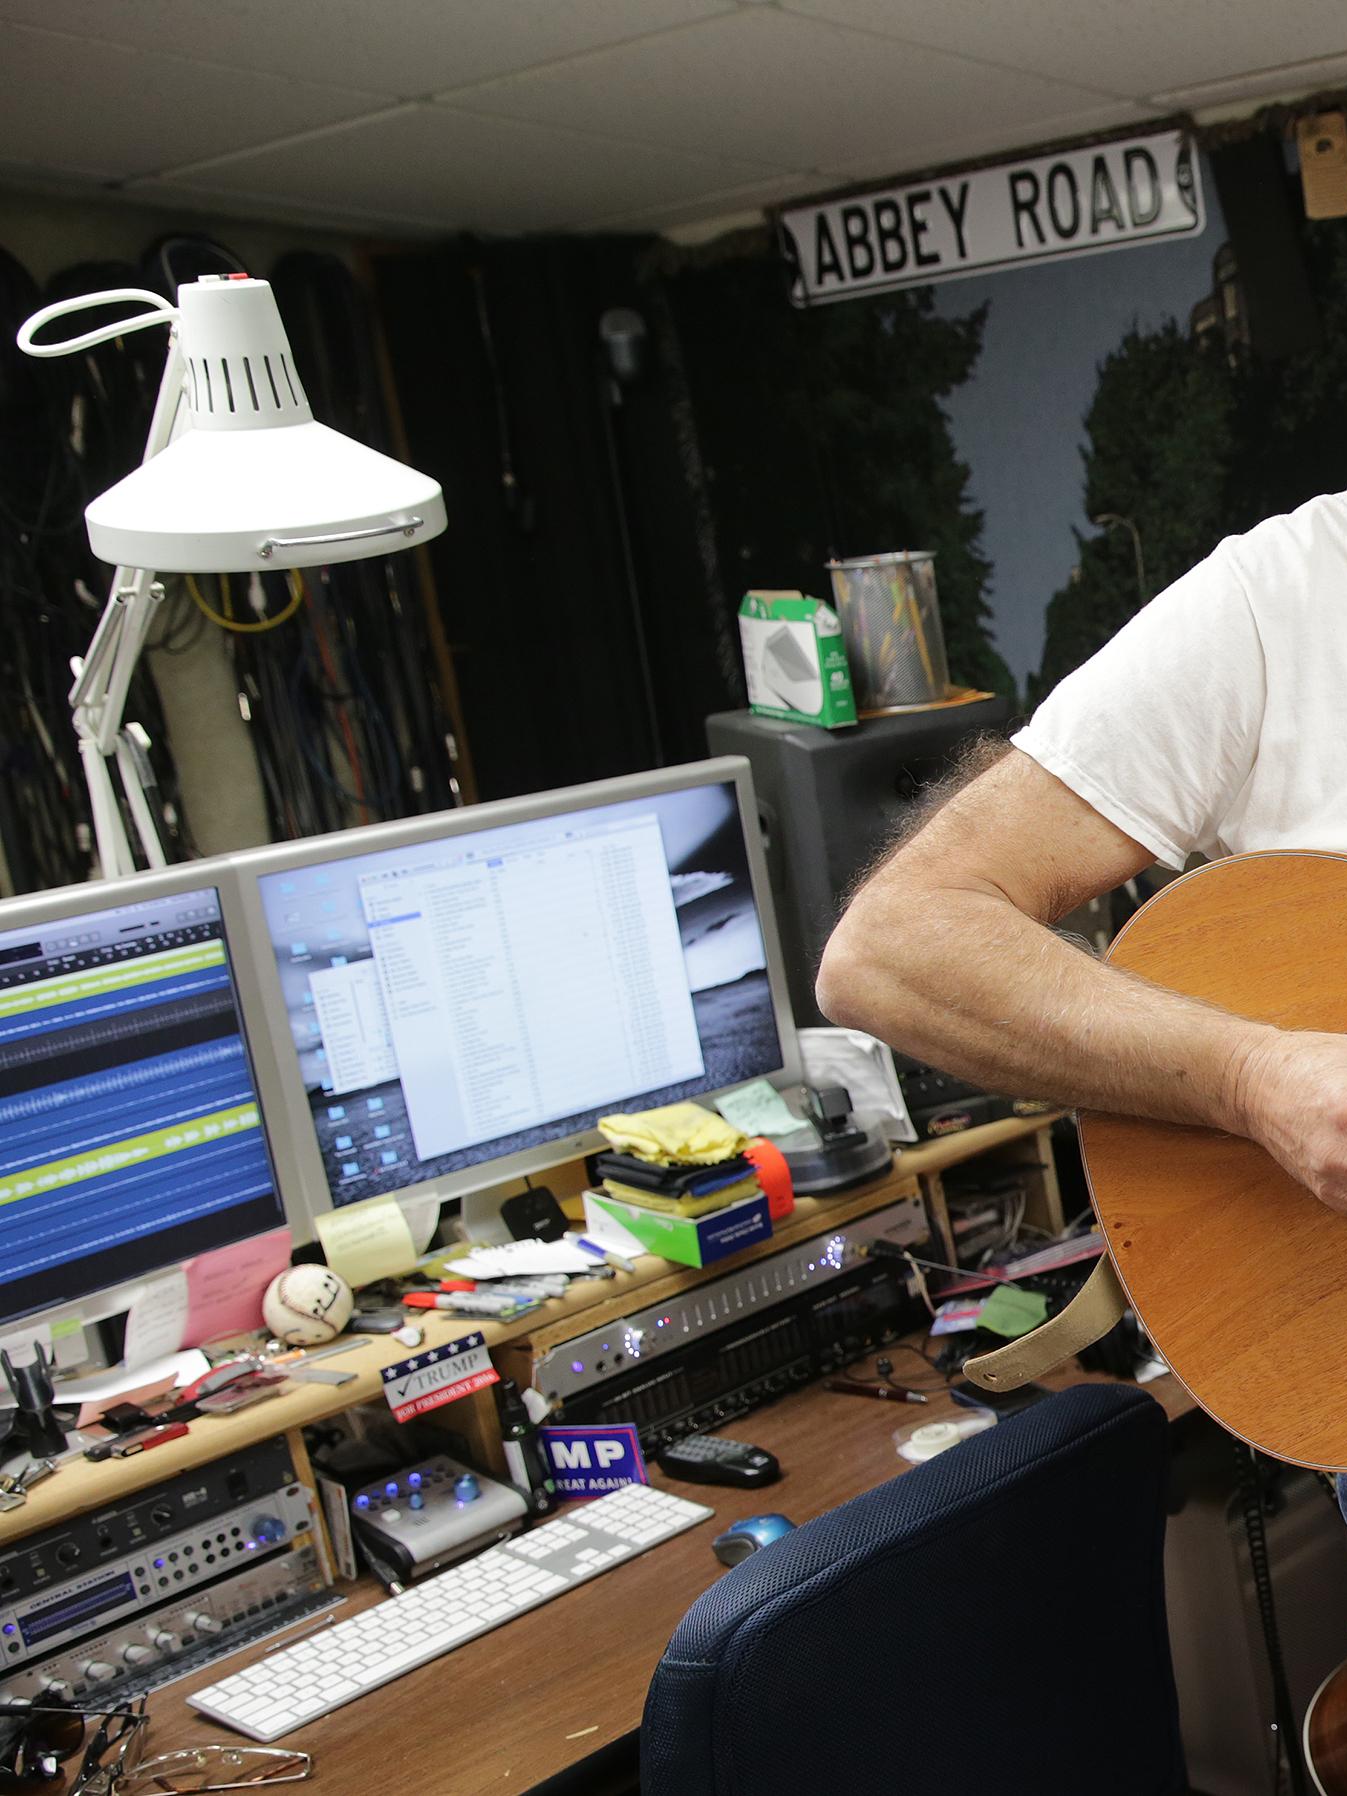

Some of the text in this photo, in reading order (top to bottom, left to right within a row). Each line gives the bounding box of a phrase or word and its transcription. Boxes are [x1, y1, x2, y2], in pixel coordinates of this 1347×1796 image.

[814, 146, 1163, 286] ABBEY ROAD
[414, 1353, 478, 1389] TRUMP
[555, 1478, 586, 1491] REAT
